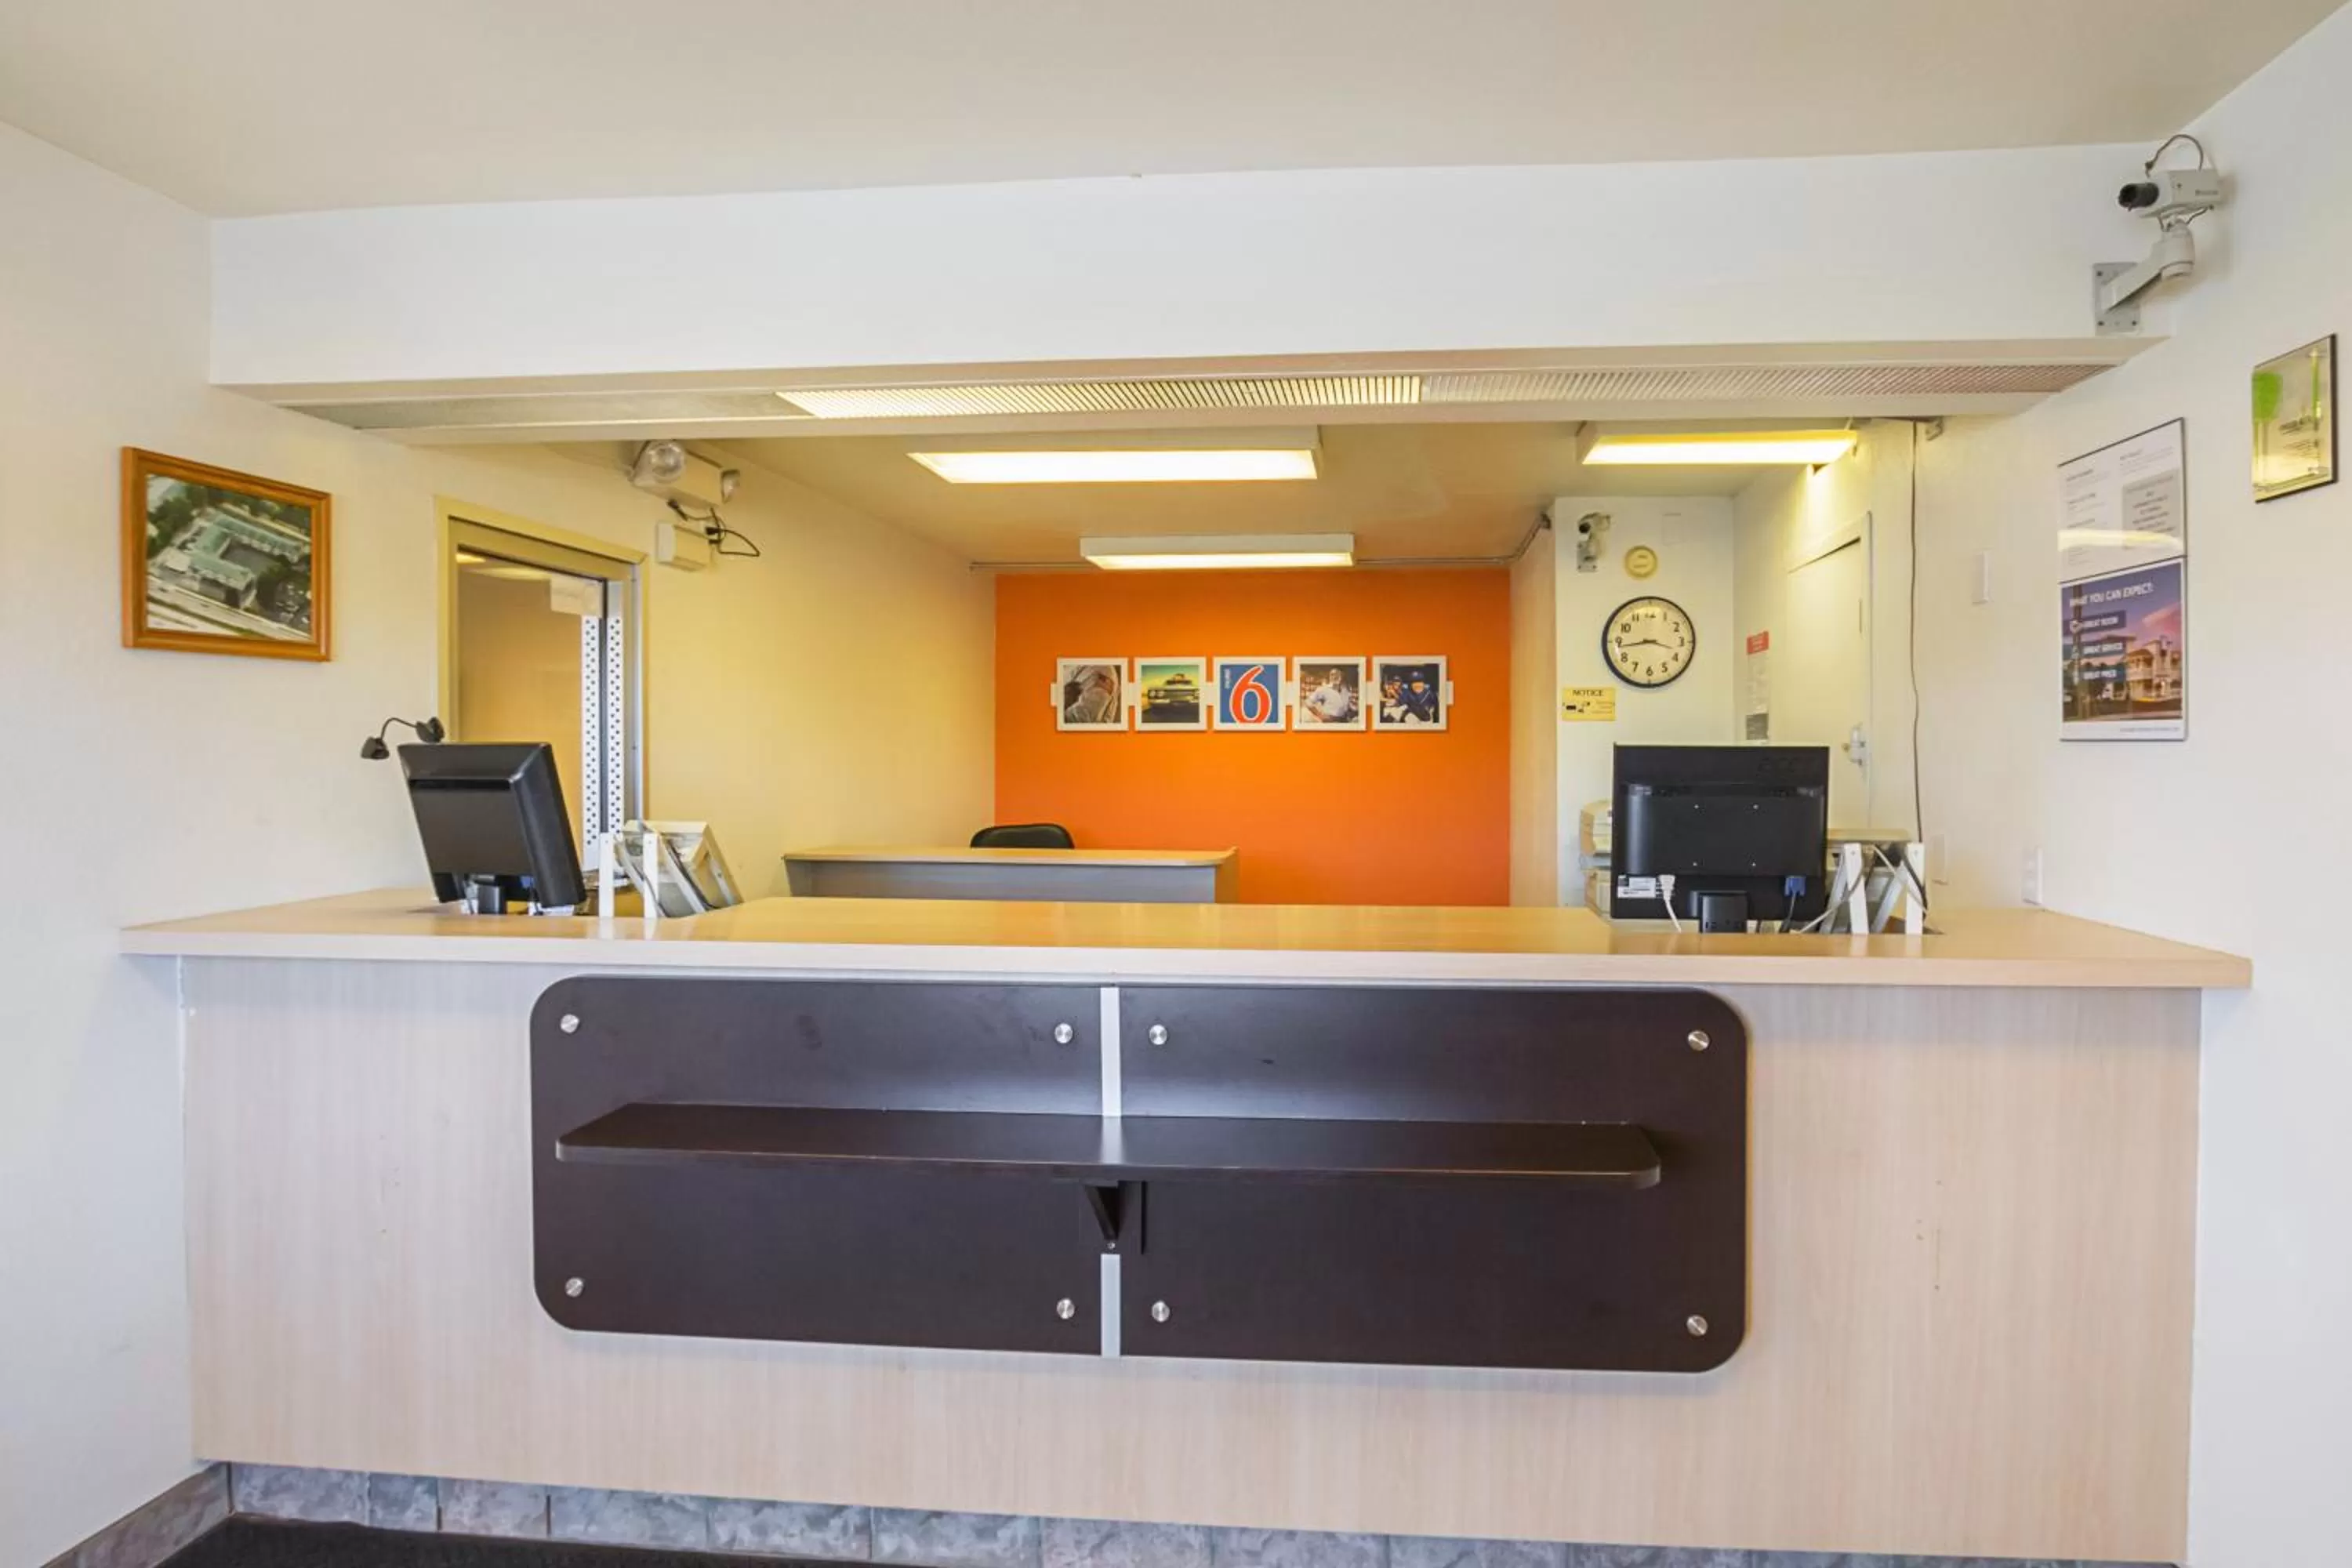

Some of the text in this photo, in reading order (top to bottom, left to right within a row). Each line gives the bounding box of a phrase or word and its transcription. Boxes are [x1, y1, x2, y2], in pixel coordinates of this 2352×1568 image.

[2106, 589, 2122, 601] CAN
[1621, 622, 1632, 633] 10
[1673, 622, 1680, 633] 2
[1615, 636, 1623, 648] 9
[1679, 636, 1685, 647] 3
[1621, 652, 1628, 663] 8
[1671, 652, 1679, 662] 4
[1632, 661, 1639, 673] 7
[1646, 666, 1653, 677] 6
[1661, 662, 1668, 673] 5
[1229, 665, 1272, 724] 6
